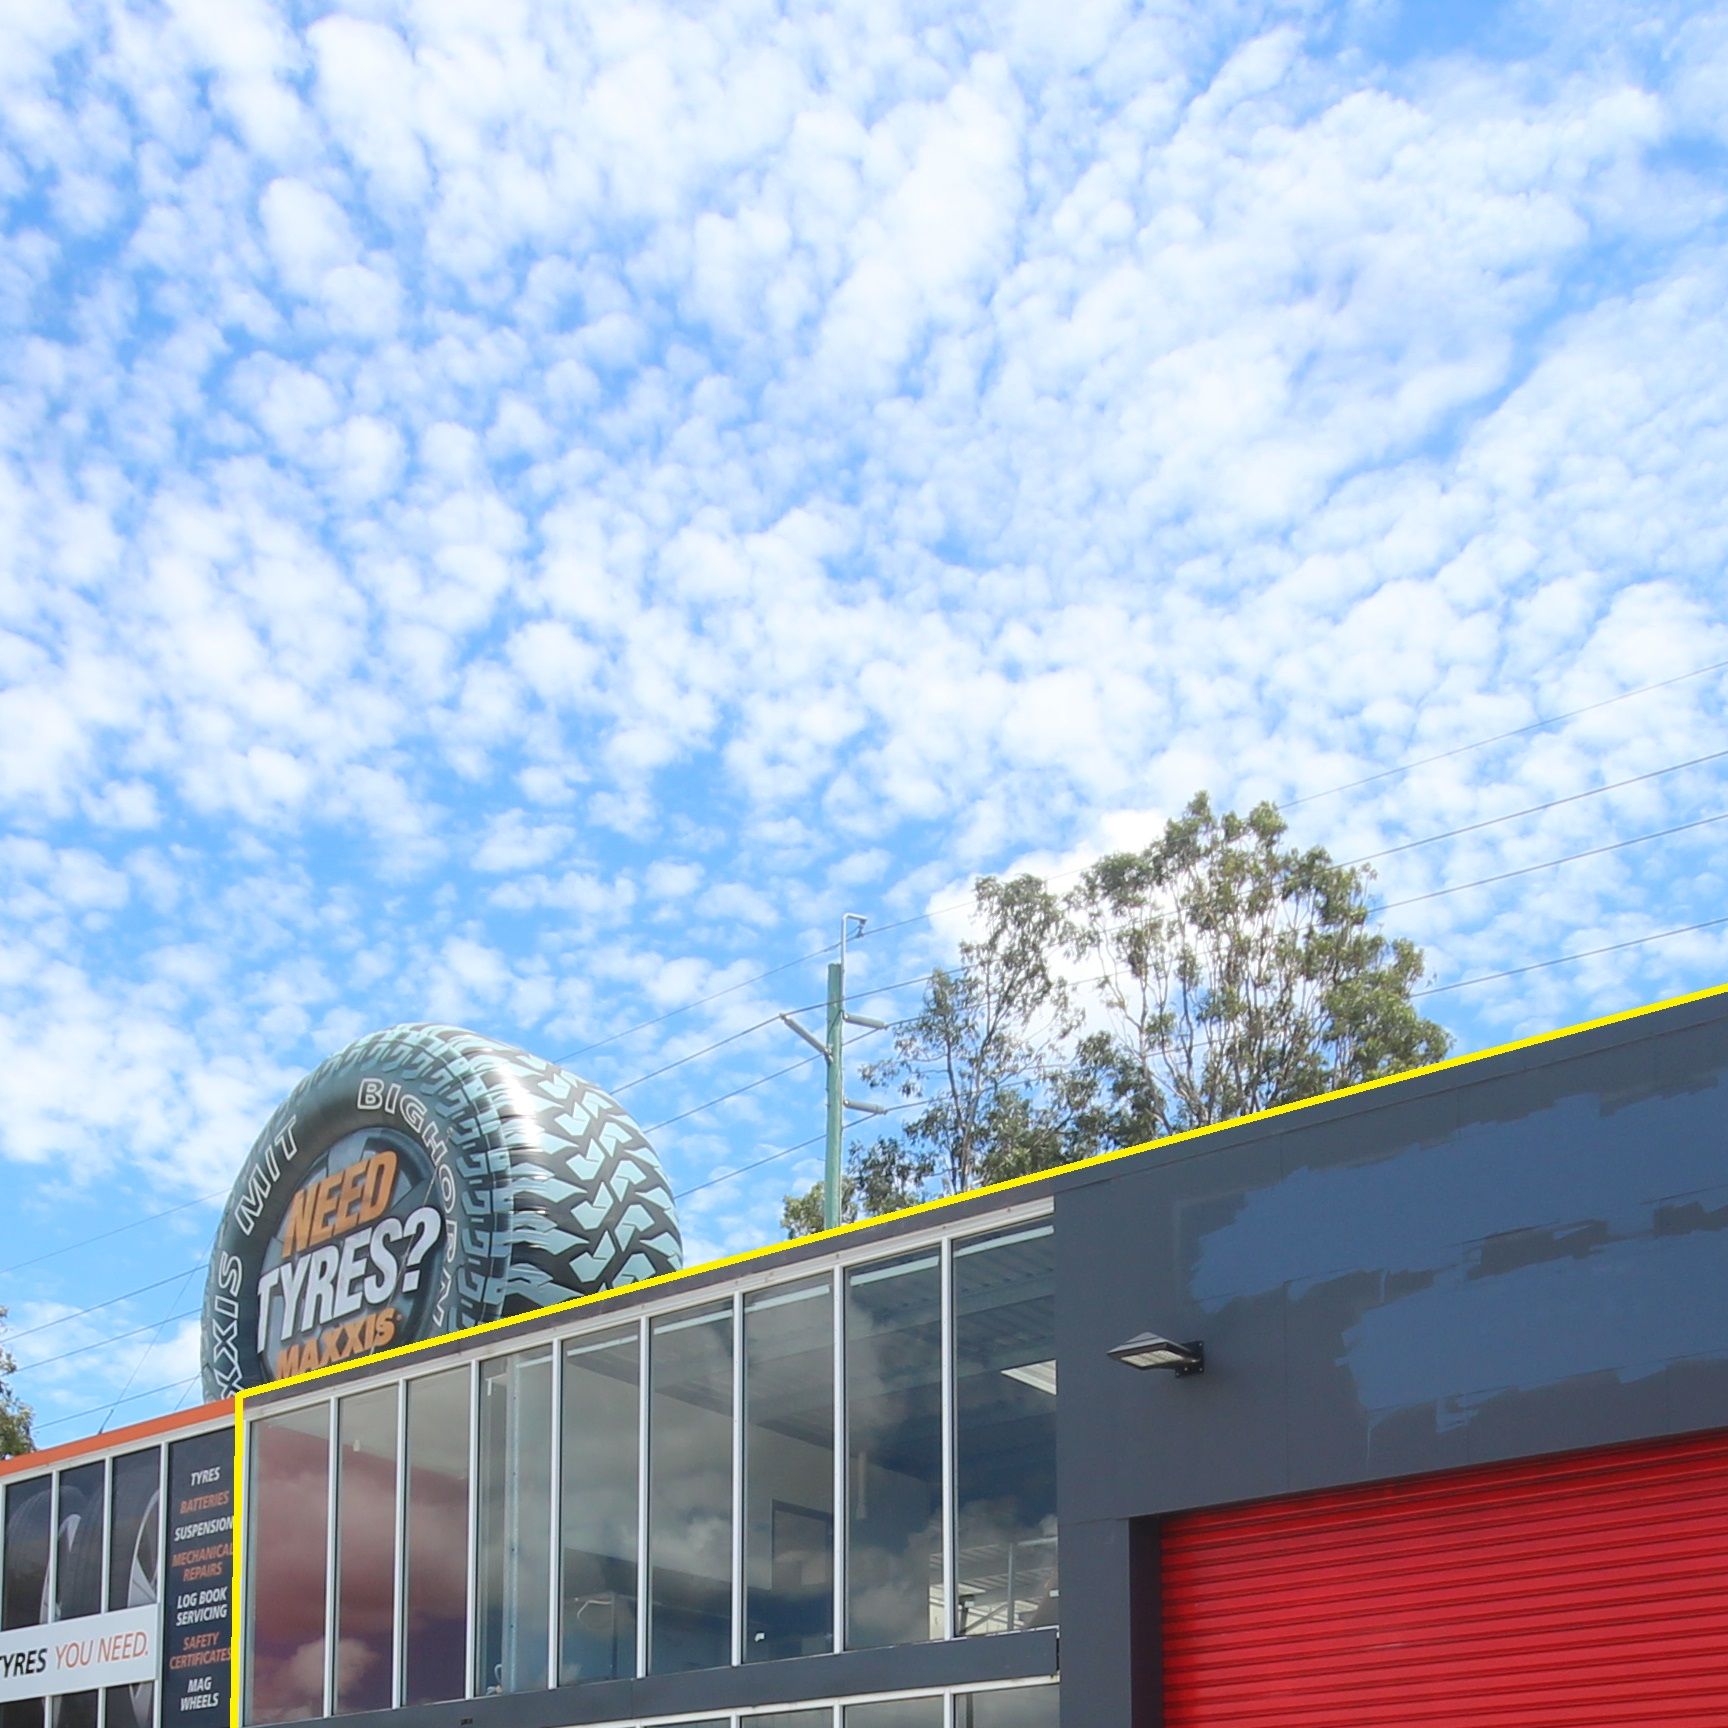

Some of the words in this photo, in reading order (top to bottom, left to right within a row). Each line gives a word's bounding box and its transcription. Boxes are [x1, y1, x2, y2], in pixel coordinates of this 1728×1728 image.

[281, 1150, 398, 1258] NEED
[257, 1205, 442, 1353] TYRES?
[274, 1306, 398, 1381] MAXXIS
[190, 1467, 220, 1486] TYRES
[180, 1490, 230, 1514] BATTERIES
[174, 1515, 234, 1541] SUSPENSION
[172, 1542, 233, 1567] MECHANICAL
[183, 1561, 223, 1581] REPAIRS
[176, 1592, 198, 1609] LOG
[198, 1586, 228, 1605] BOOK
[176, 1604, 228, 1626] SERVICING
[55, 1639, 94, 1670] YOU
[97, 1631, 149, 1663] NEED.
[183, 1632, 220, 1651] SAFETY
[169, 1647, 232, 1670] CERTIFICATES
[187, 1676, 212, 1693] MAG
[180, 1693, 220, 1711] WHEELS
